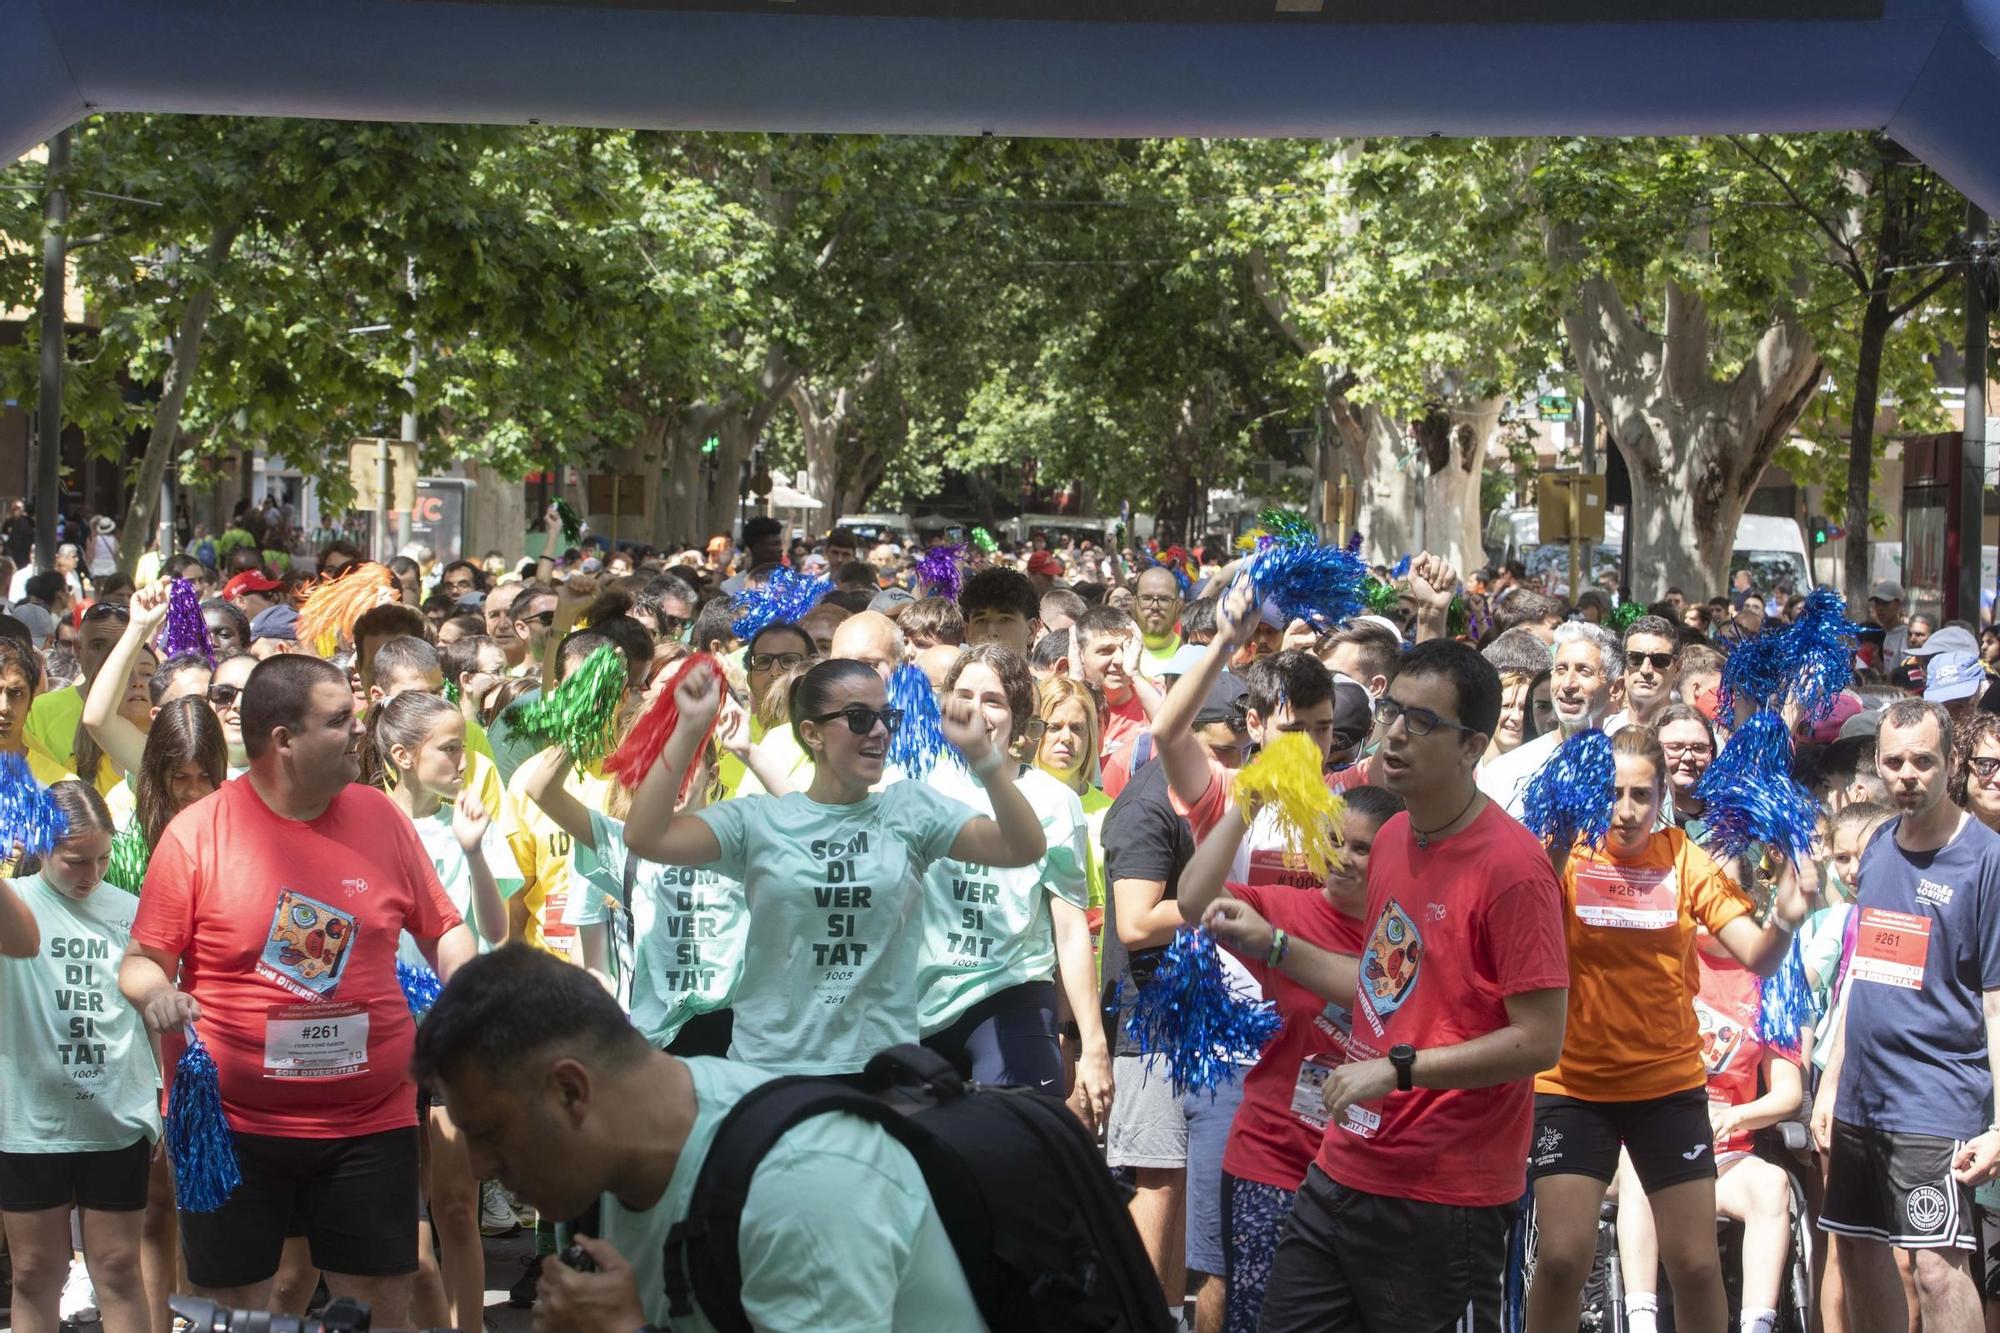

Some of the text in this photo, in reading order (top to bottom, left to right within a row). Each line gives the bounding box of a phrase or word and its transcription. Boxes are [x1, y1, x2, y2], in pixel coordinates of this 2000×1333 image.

[810, 831, 869, 860] SOM
[664, 866, 719, 886] SOM
[826, 860, 856, 883] DI
[965, 861, 990, 877] DI
[677, 890, 705, 911] DI
[814, 886, 872, 908] VER
[952, 879, 1000, 905] VER
[1609, 884, 1643, 896] #261
[666, 916, 717, 938] VER
[827, 913, 855, 937] SI
[962, 907, 983, 930] SI
[51, 936, 109, 959] SOM
[947, 931, 994, 958] TAT
[1875, 931, 1900, 947] #261
[676, 943, 701, 965] SI
[812, 943, 867, 966] TAT
[952, 959, 979, 968] 1005
[65, 965, 93, 985] DI
[665, 970, 715, 991] TAT
[825, 971, 854, 980] 1005
[55, 990, 104, 1012] VER
[824, 995, 846, 1004] 261
[70, 1017, 94, 1038] SI
[302, 1025, 338, 1039] #261
[58, 1044, 107, 1065] TAT
[72, 1070, 99, 1078] 1005
[275, 1065, 360, 1077] SOM DIVERSITAT
[76, 1092, 95, 1101] 261
